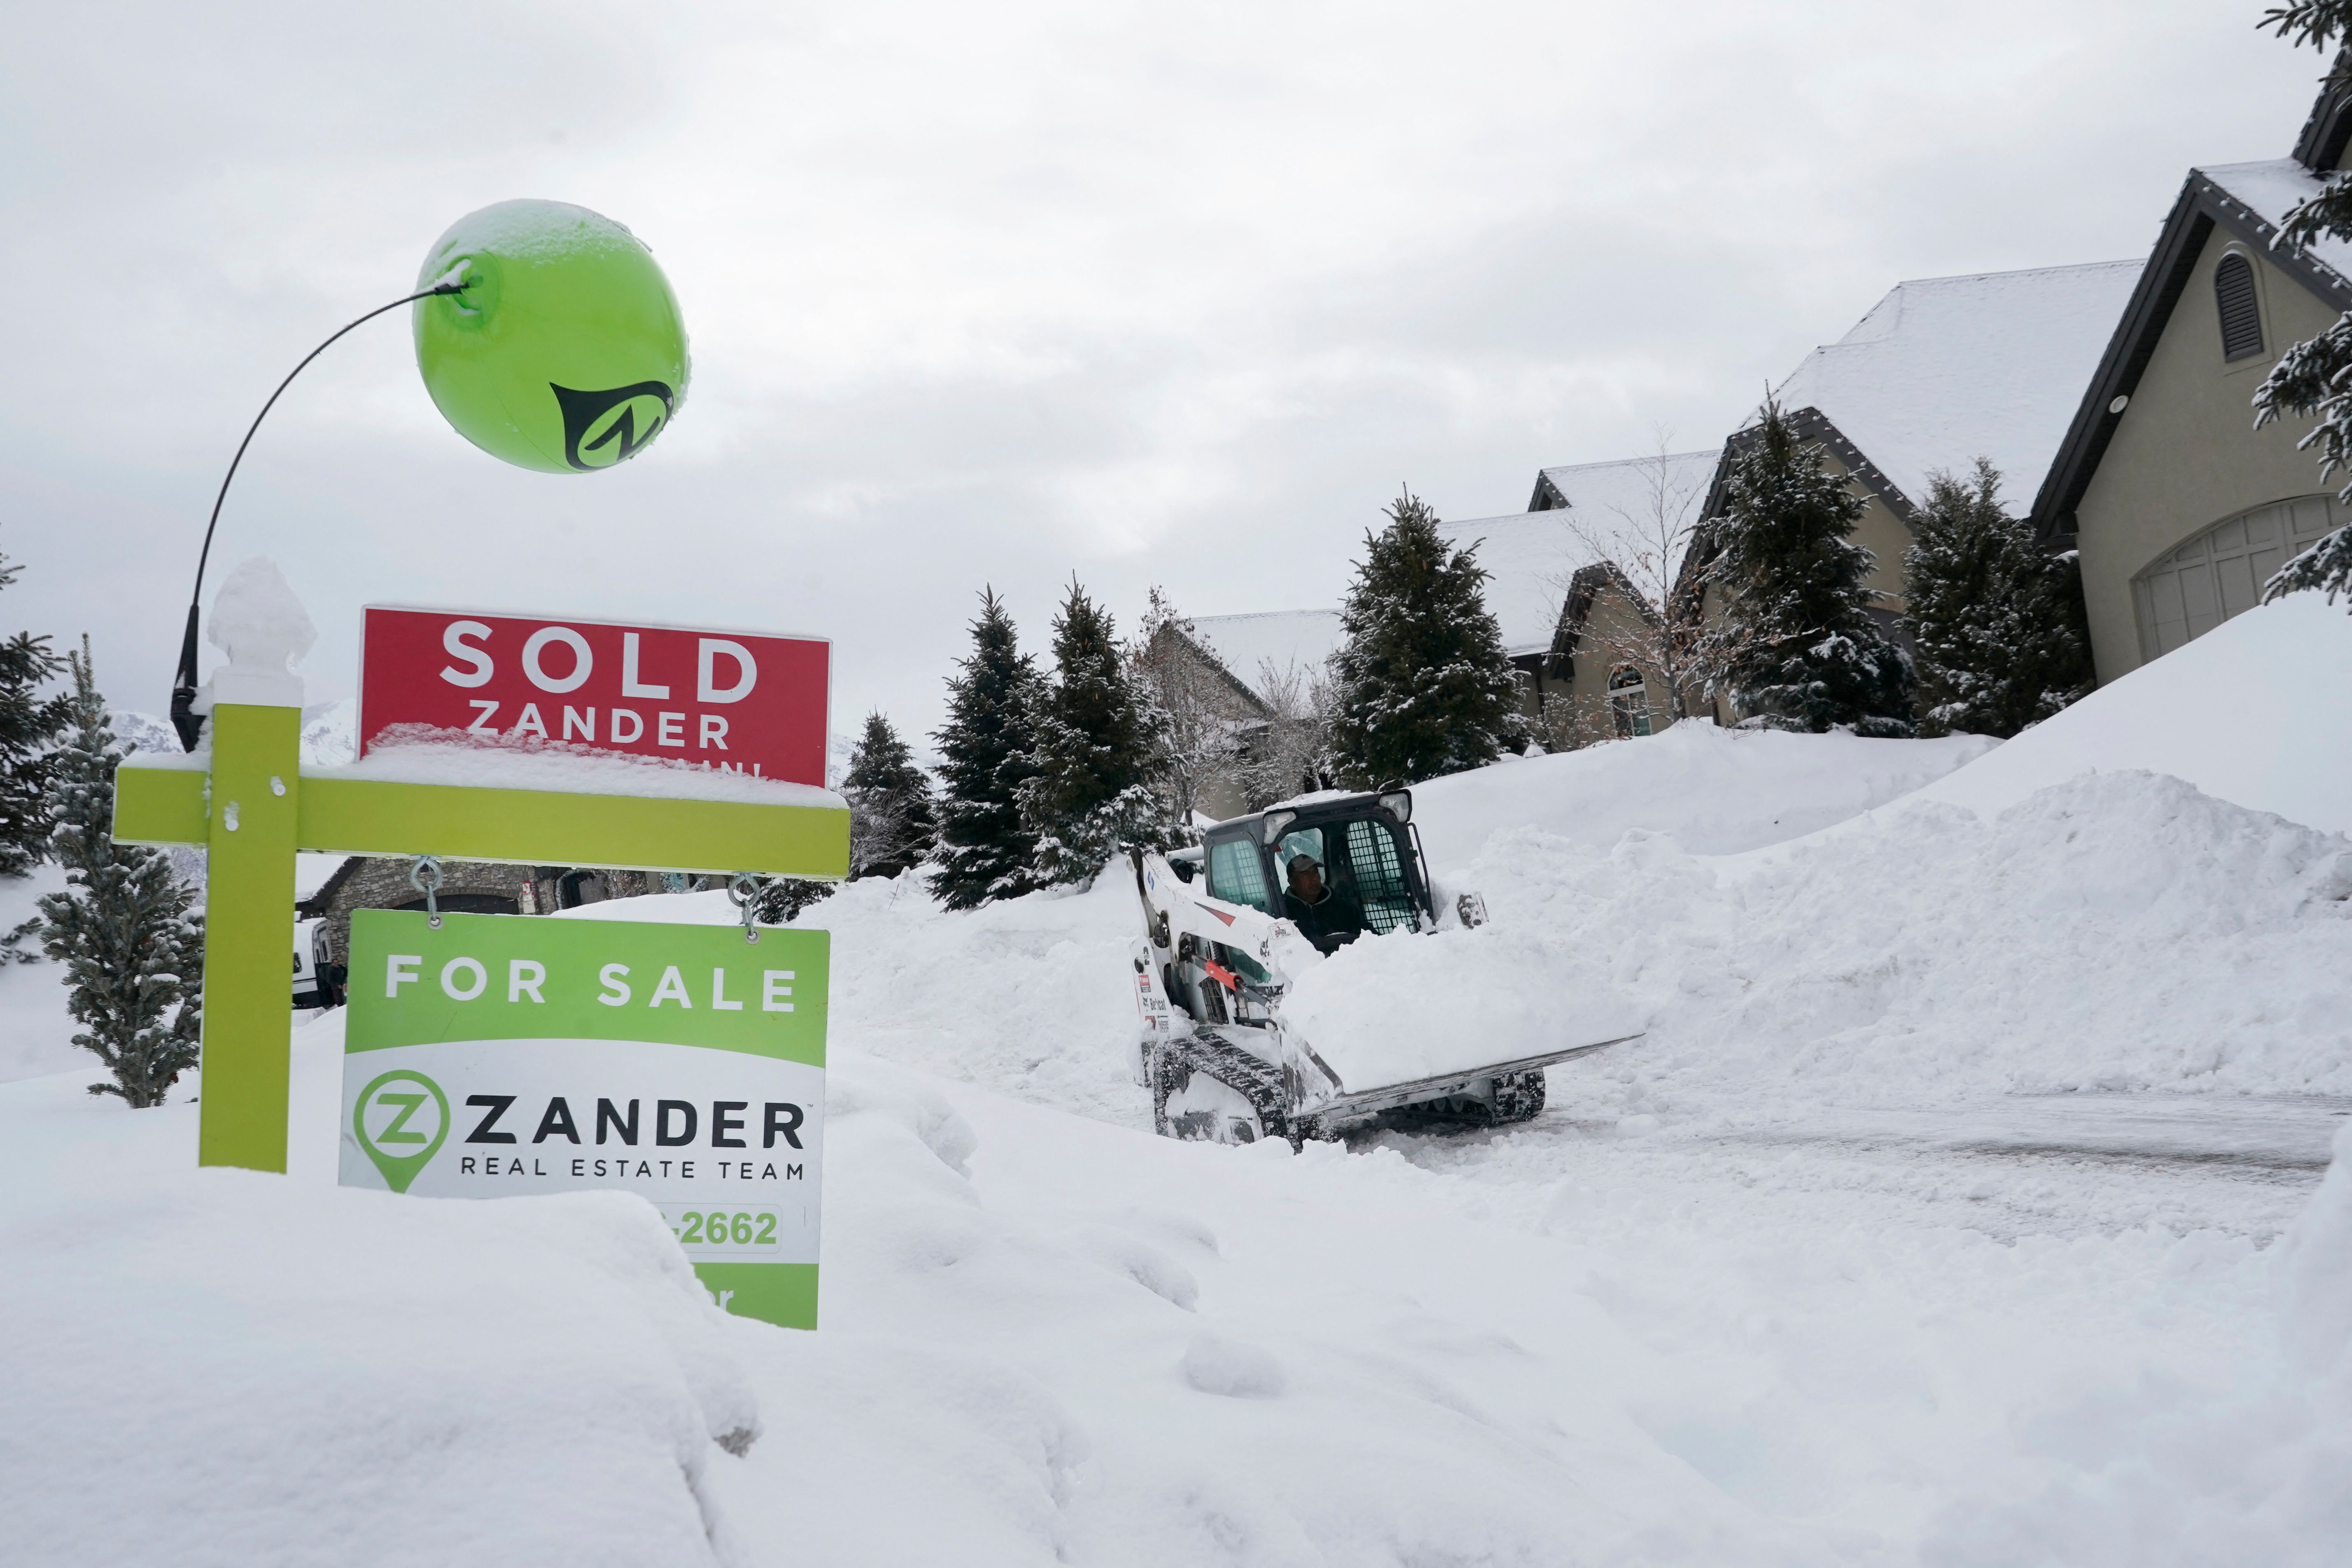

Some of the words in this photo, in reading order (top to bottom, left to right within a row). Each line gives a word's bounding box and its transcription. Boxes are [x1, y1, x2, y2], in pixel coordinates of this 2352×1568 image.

[439, 620, 758, 704] SOLD
[467, 699, 729, 750] ZANDER
[386, 954, 547, 1004] FOR
[597, 963, 795, 1012] SALE
[464, 1095, 804, 1149] ZANDER
[461, 1157, 547, 1176] REAL
[572, 1159, 695, 1178] ESTATE
[719, 1162, 803, 1181] TEAM
